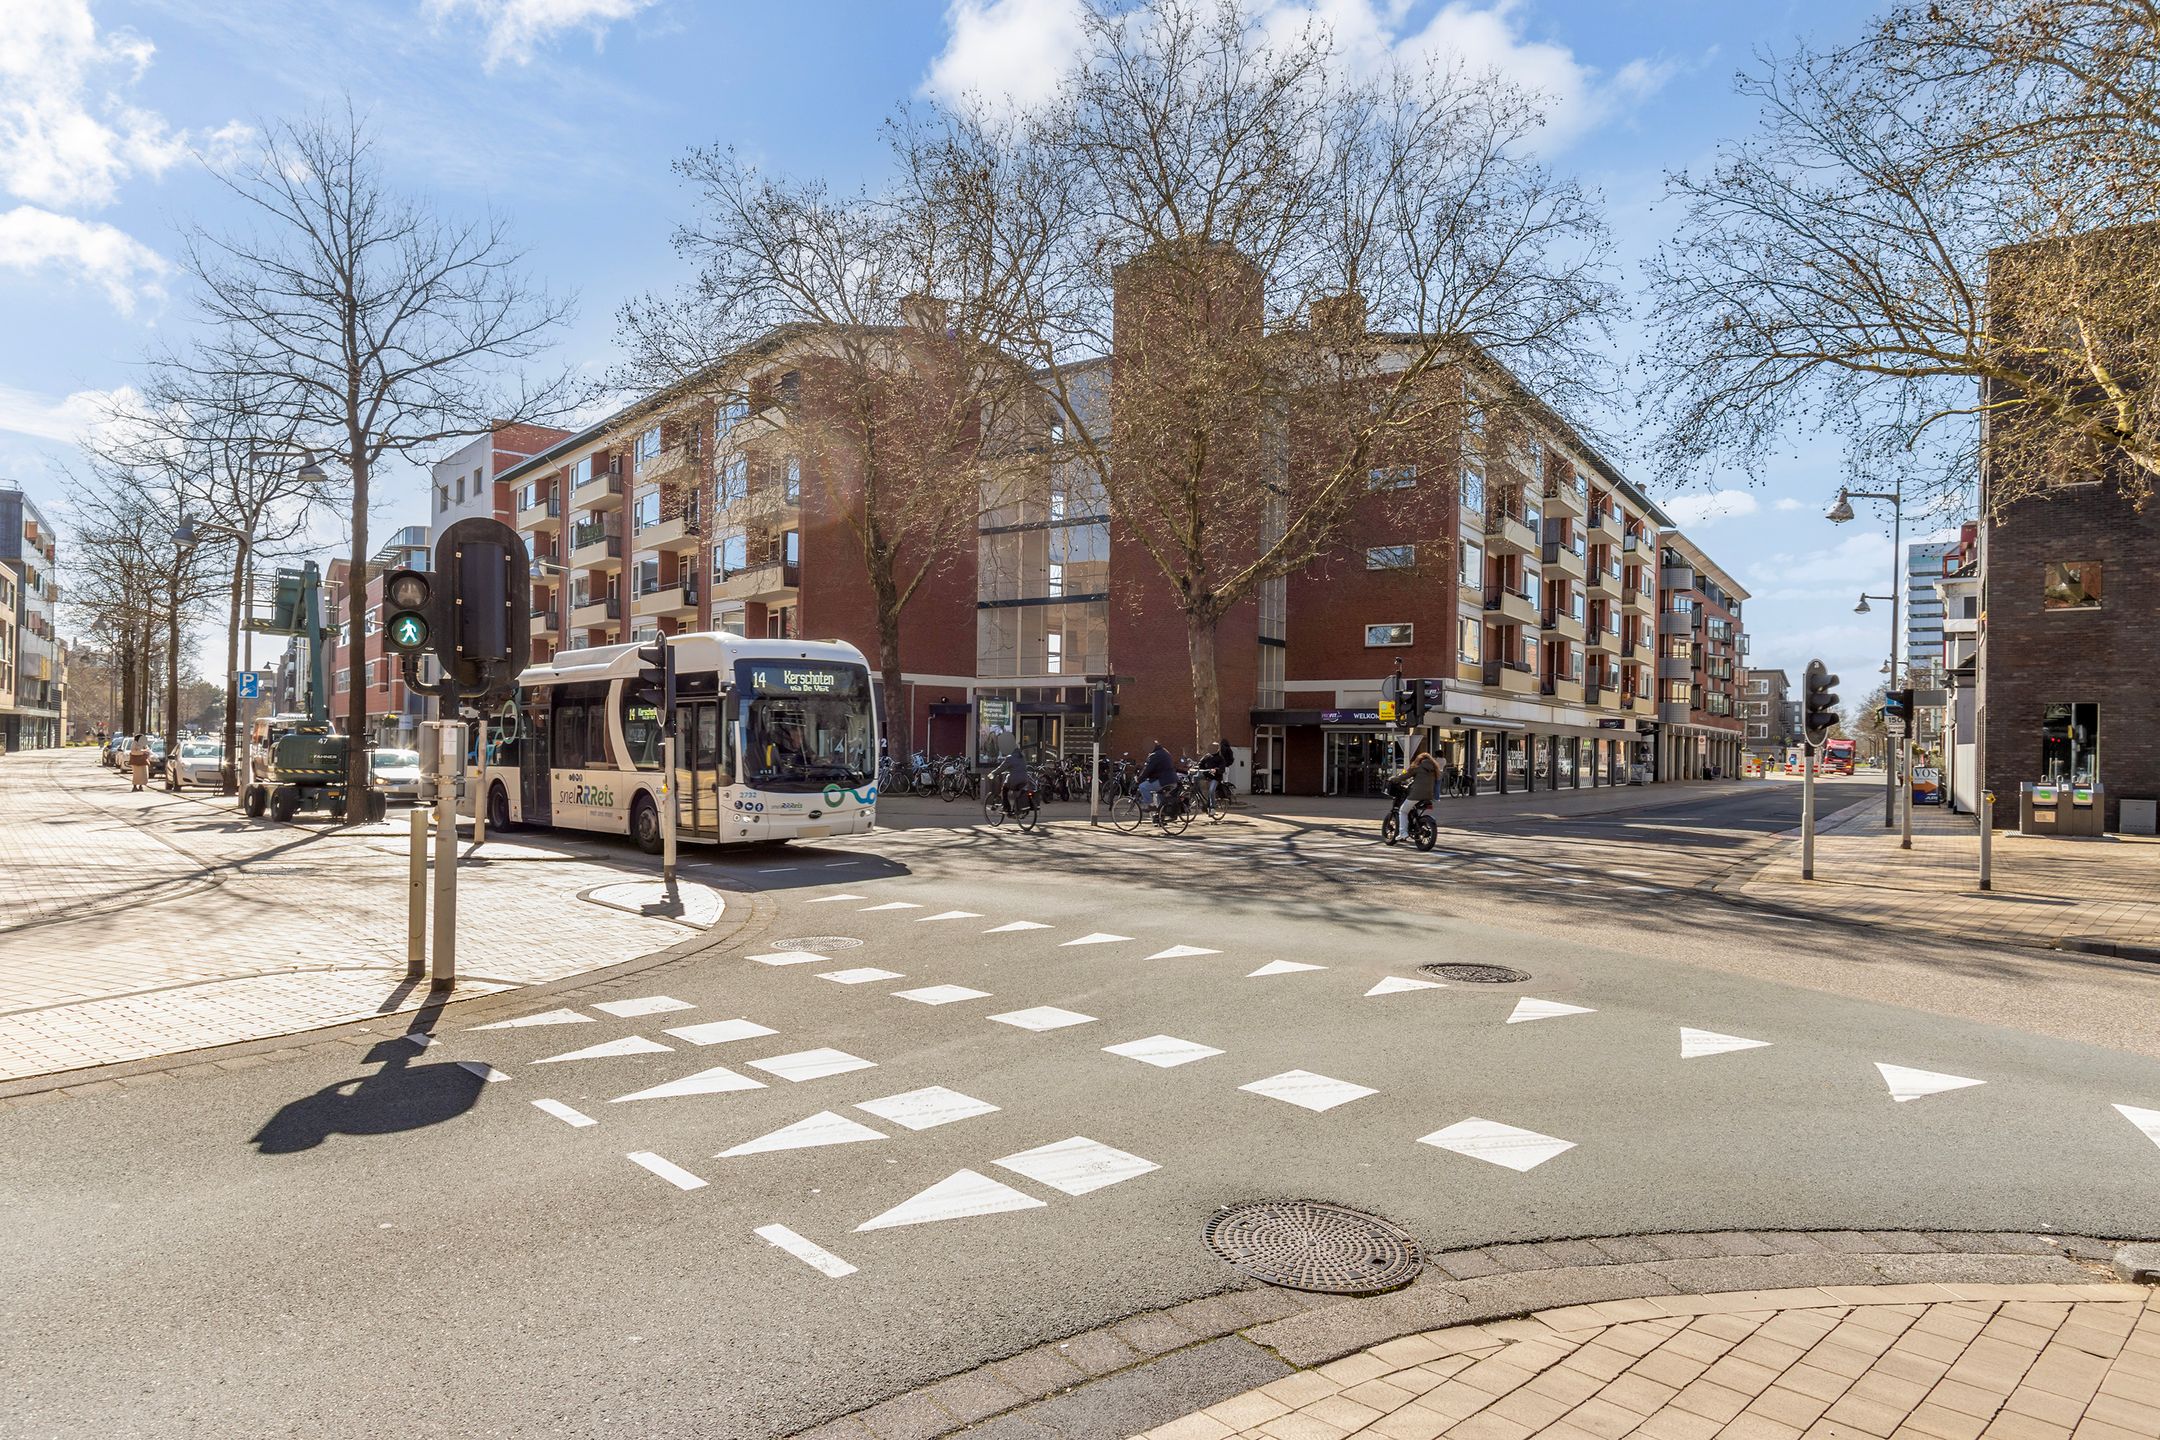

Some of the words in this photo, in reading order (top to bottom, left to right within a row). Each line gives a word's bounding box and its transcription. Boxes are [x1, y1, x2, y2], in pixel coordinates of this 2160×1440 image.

[242, 674, 255, 687] P
[753, 671, 767, 688] 14
[783, 670, 835, 685] Kerschoten
[1914, 768, 1938, 778] VOS
